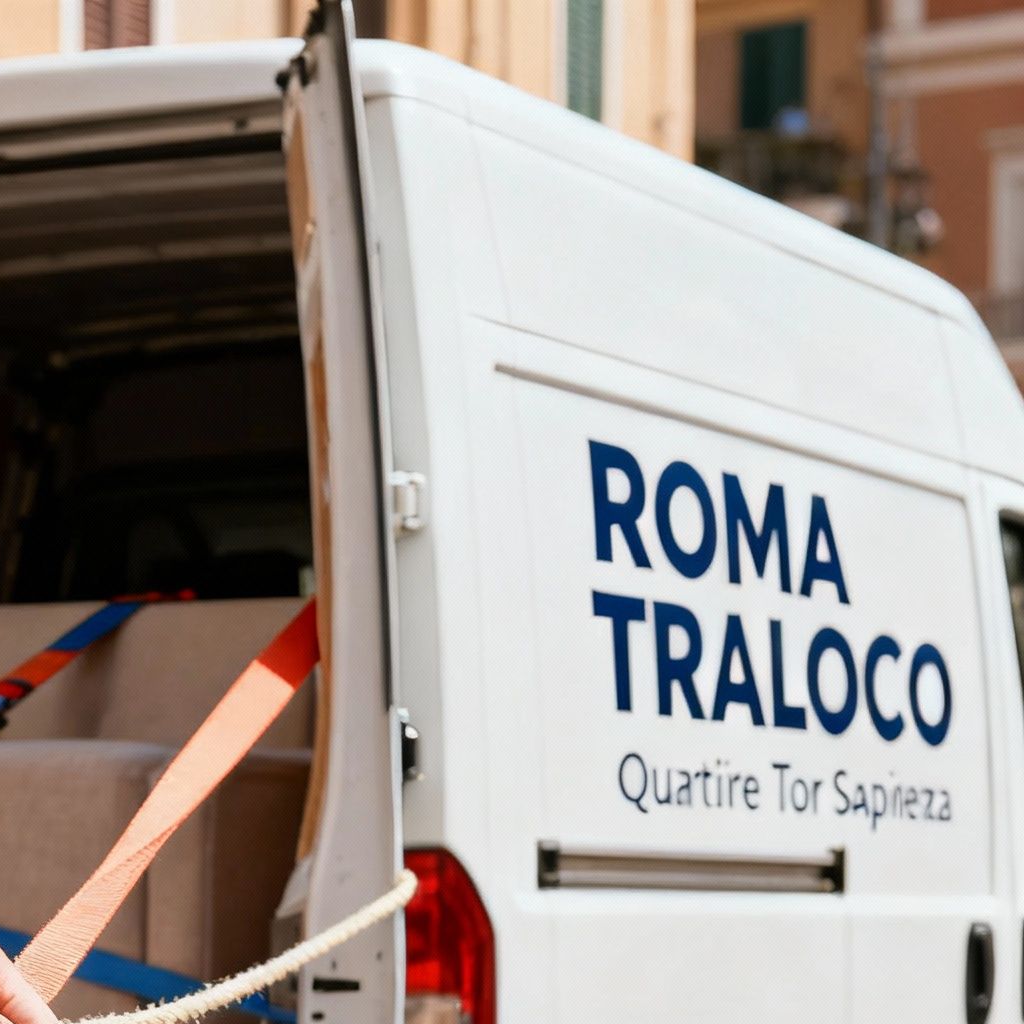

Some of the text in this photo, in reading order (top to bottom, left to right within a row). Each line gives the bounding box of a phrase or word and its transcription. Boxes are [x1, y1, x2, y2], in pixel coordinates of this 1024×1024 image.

[588, 439, 851, 606] ROMA
[591, 589, 953, 748] TRALOCO
[772, 763, 823, 813] Tor
